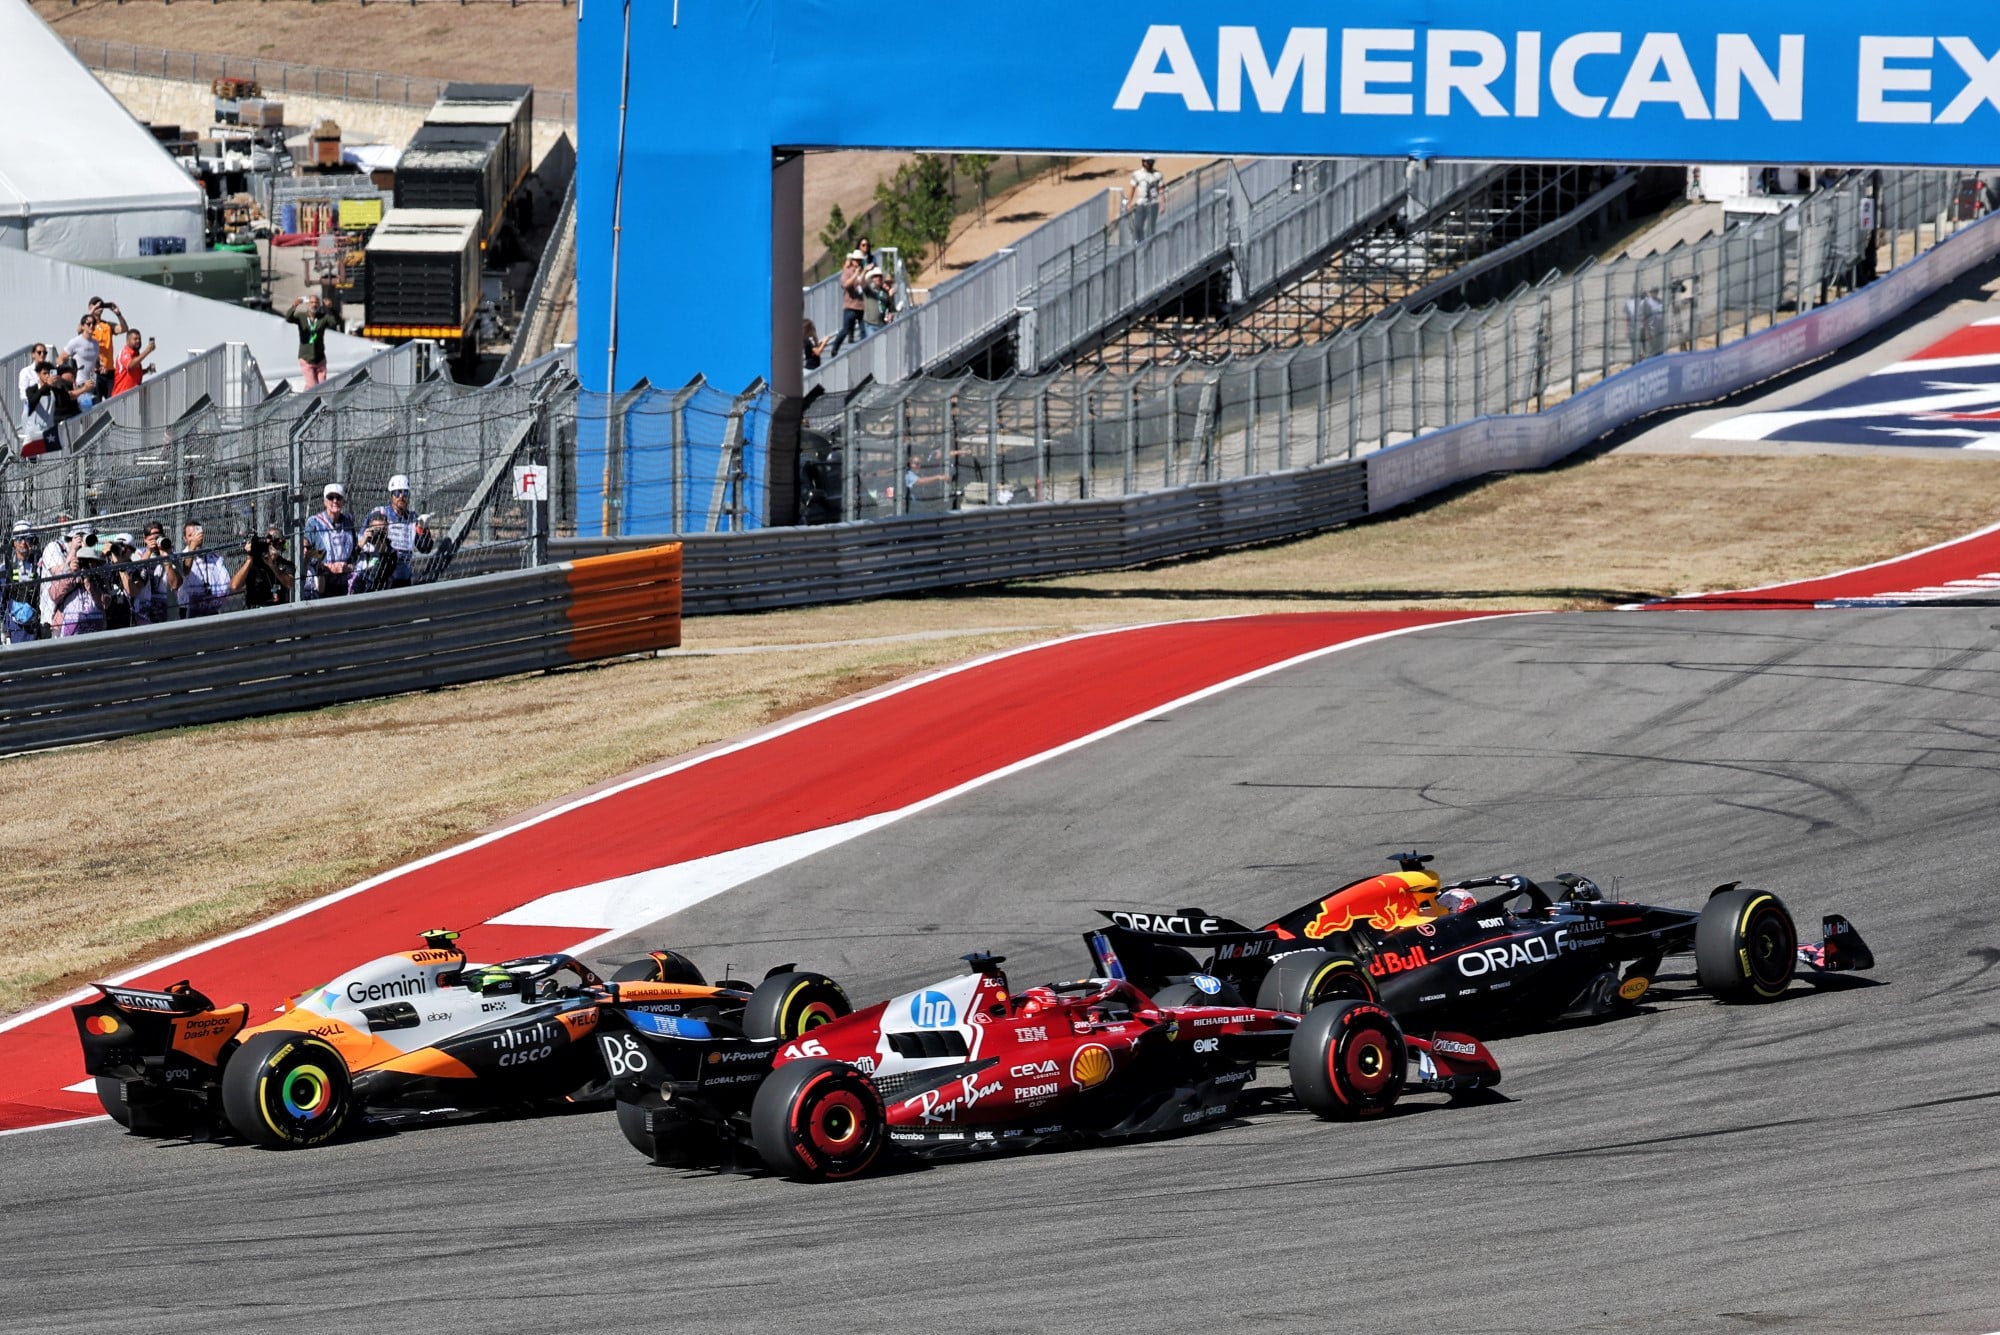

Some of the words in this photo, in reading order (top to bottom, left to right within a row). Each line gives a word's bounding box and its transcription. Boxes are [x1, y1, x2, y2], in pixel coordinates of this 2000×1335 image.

[1112, 24, 1805, 121] AMERICAN
[523, 473, 536, 492] F
[1112, 912, 1219, 935] ORACLE
[1219, 941, 1259, 960] Mobil
[1458, 930, 1567, 976] ORACLE
[347, 972, 426, 1003] Gemini
[650, 1004, 680, 1012] WORLD
[919, 992, 949, 1025] hp
[186, 1017, 230, 1029] Dropbox
[427, 1011, 452, 1022] ebay
[1193, 1017, 1229, 1027] RICHARD
[1231, 1015, 1255, 1024] MILLE
[183, 1030, 210, 1040] Dash
[308, 1024, 344, 1037] DELL
[1014, 1026, 1048, 1043] IBM
[721, 1051, 770, 1063] V-Power
[1014, 1083, 1058, 1099] PERONI
[890, 1132, 925, 1141] brembo
